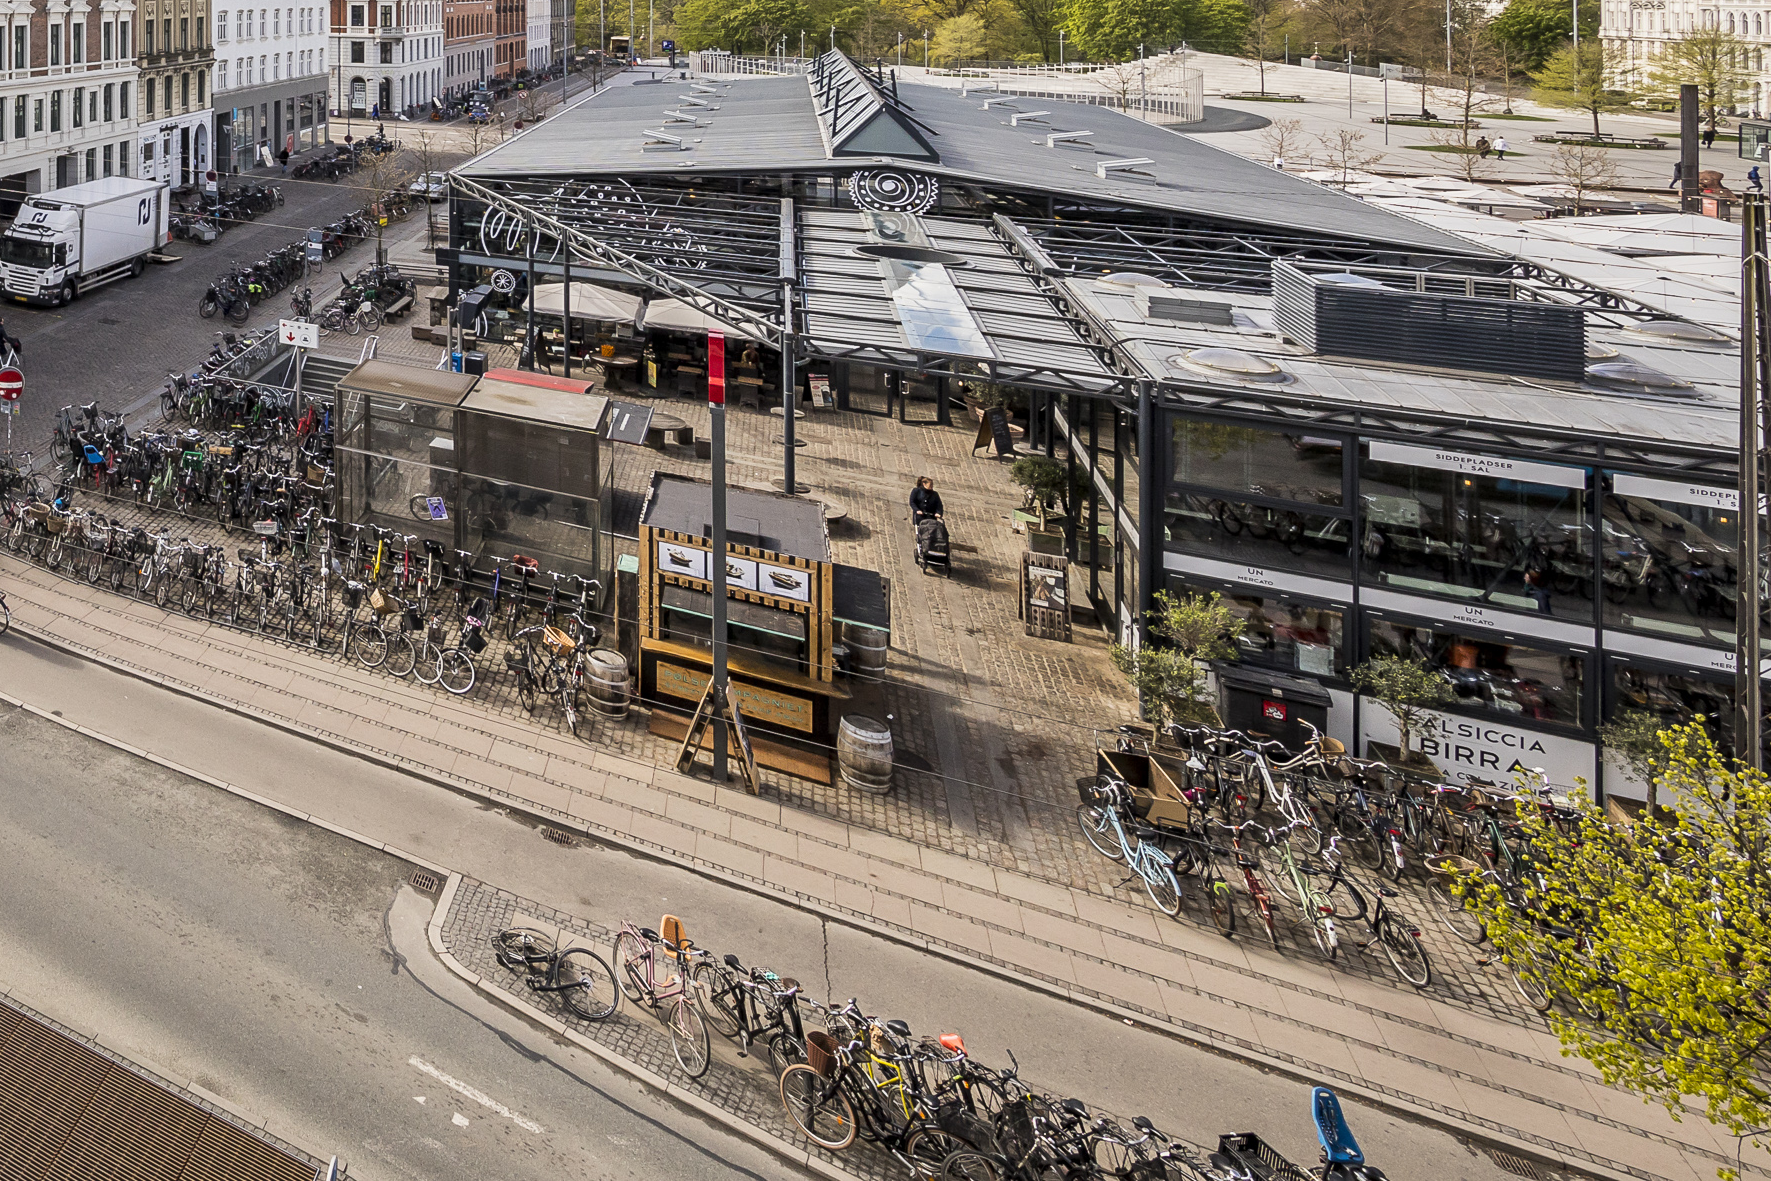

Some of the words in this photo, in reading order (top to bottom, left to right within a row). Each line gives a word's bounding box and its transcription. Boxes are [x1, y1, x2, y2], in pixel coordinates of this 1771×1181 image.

[1435, 453, 1513, 469] SIDDEPLADSER
[1471, 465, 1490, 473] SAL
[1247, 568, 1264, 576] UN
[1237, 575, 1274, 586] MERCATO
[1464, 606, 1483, 616] UN
[1453, 614, 1495, 627] MERCATO
[1421, 737, 1535, 775] BIRRA
